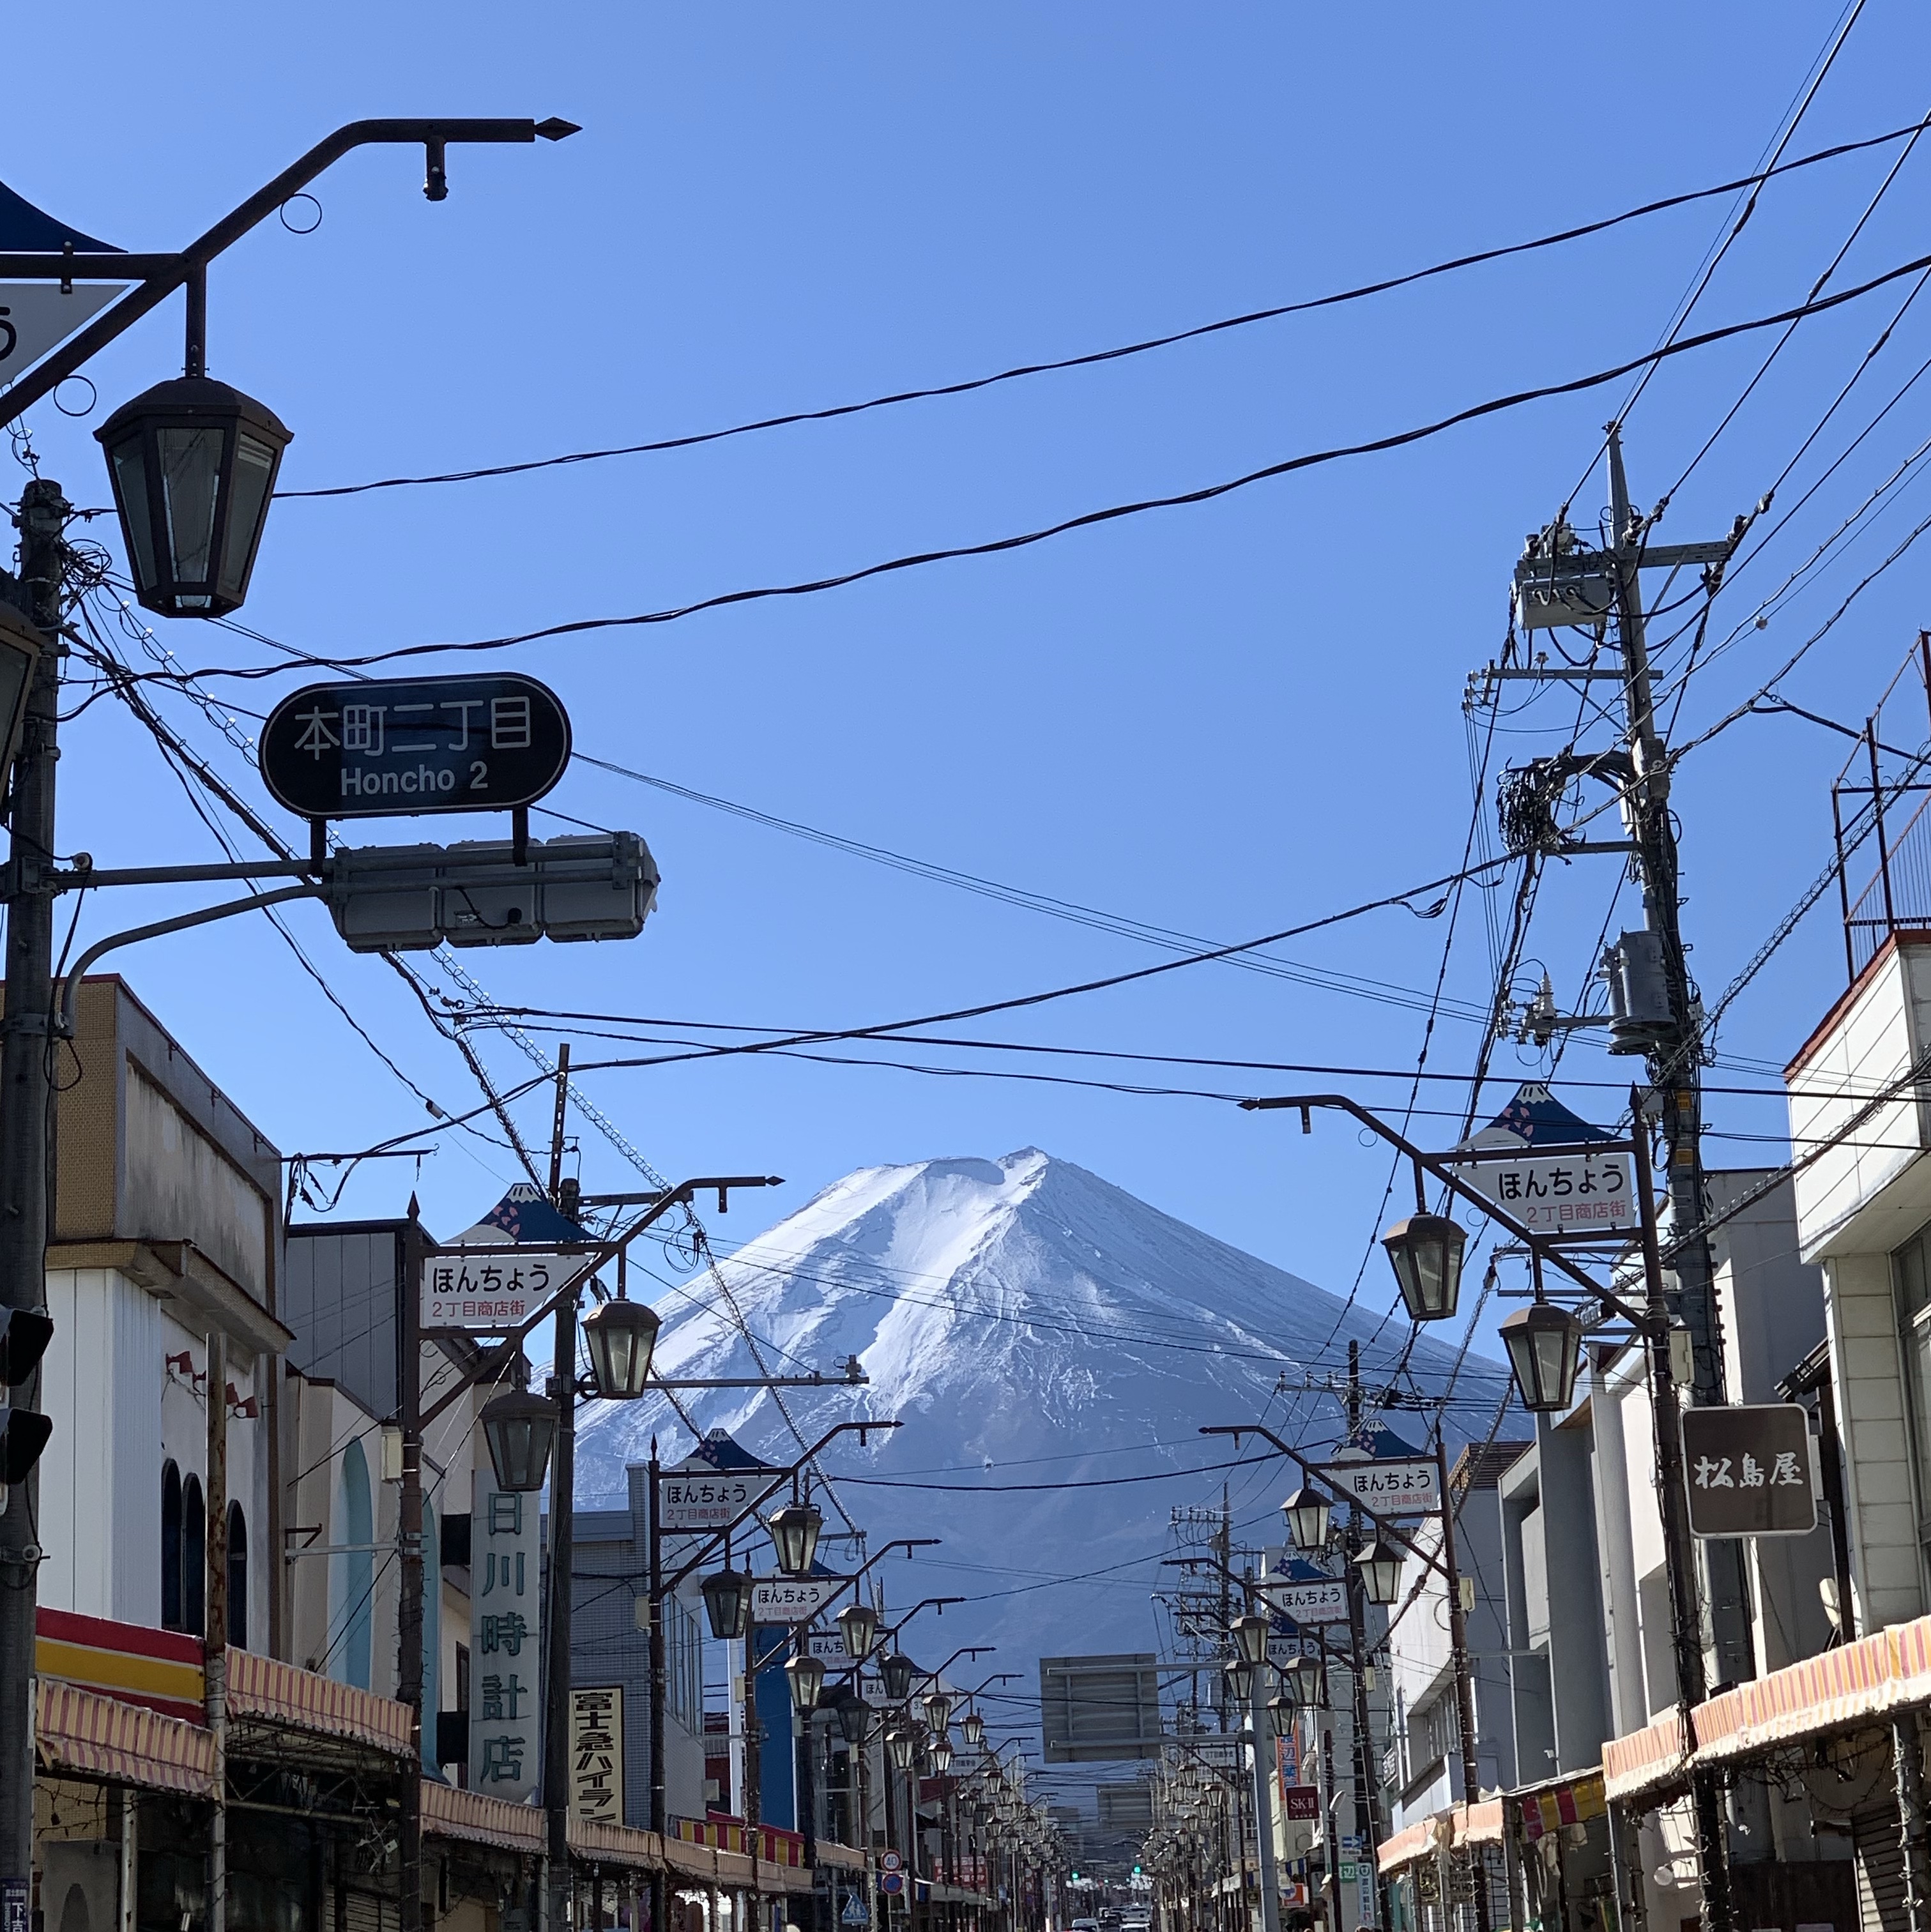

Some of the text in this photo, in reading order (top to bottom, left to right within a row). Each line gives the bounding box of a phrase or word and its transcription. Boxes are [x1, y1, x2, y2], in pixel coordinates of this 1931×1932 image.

[294, 696, 531, 761] 本町二丁目
[340, 761, 489, 796] Honcho 2
[1499, 1164, 1623, 1200] ほんちょう
[1527, 1199, 1626, 1223] 2丁目商店街
[432, 1263, 549, 1294] ほんちょう
[432, 1300, 525, 1318] 2丁目商店街
[1354, 1470, 1431, 1493] ほんちょう
[1693, 1452, 1804, 1489] 松島屋
[668, 1483, 747, 1504] ほんちょう
[758, 1587, 820, 1604] ほんちょう
[1282, 1588, 1341, 1608] ほんちょう
[885, 1856, 897, 1866] 40
